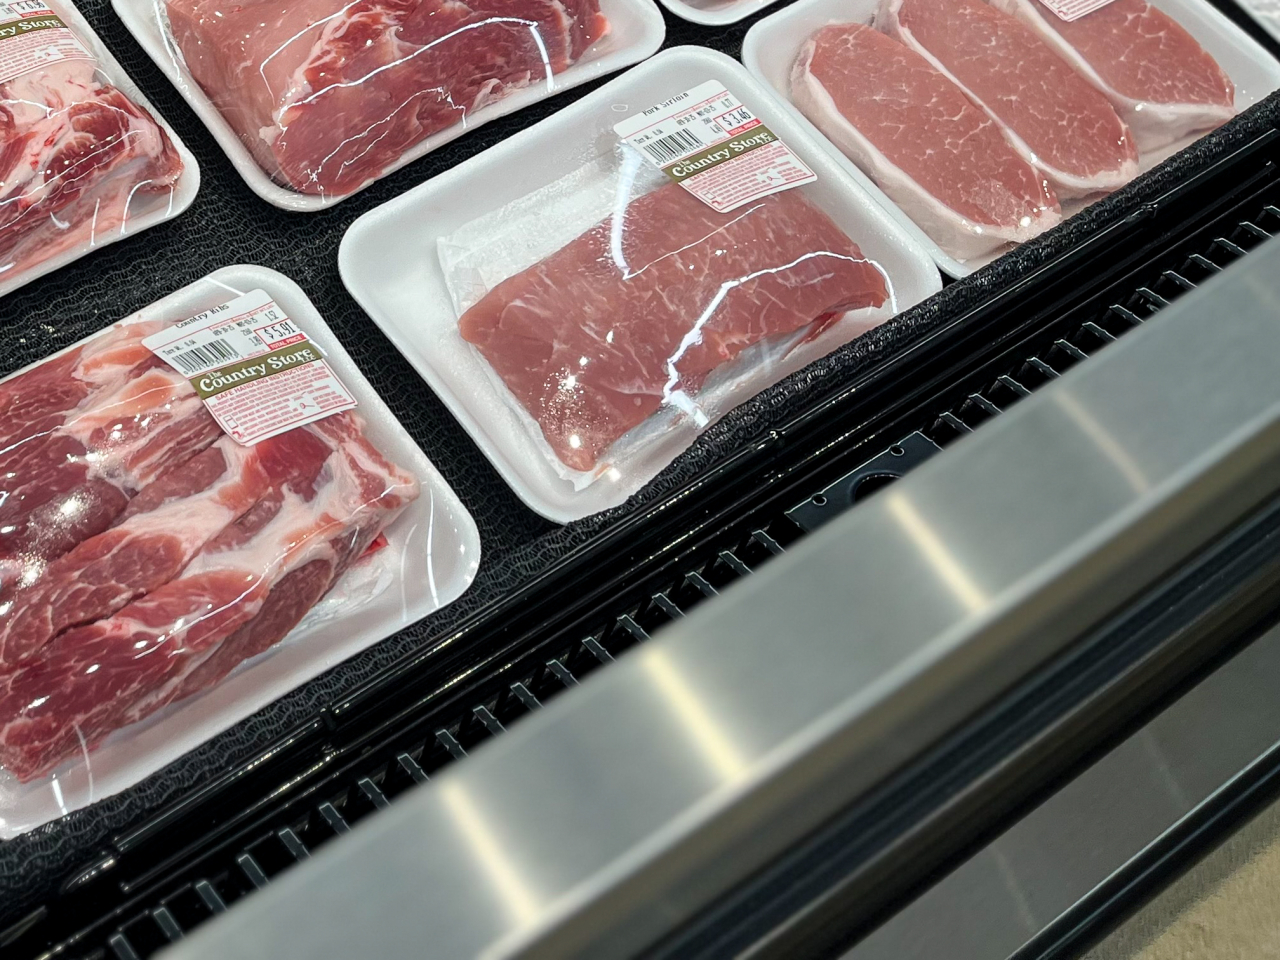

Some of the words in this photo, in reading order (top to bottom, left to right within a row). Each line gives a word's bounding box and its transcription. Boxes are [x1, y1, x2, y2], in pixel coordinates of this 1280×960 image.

[19, 18, 59, 31] Store
[642, 102, 660, 117] Pork
[661, 92, 689, 109] Sirloin
[722, 114, 733, 127] $
[731, 108, 752, 124] 3.46
[672, 148, 730, 177] Country
[729, 131, 768, 152] Store
[676, 159, 691, 168] The
[175, 312, 208, 329] Country
[209, 304, 230, 315] Ribs
[263, 327, 274, 340] $
[271, 321, 296, 337] 5.91
[270, 341, 287, 350] TOTAL
[286, 335, 302, 344] PRICE
[200, 362, 266, 392] Country
[267, 347, 312, 370] Store
[206, 370, 222, 381] The
[214, 390, 234, 401] SAFE
[234, 378, 269, 393] HANDLING
[270, 362, 315, 381] INSTRUCTIONS
